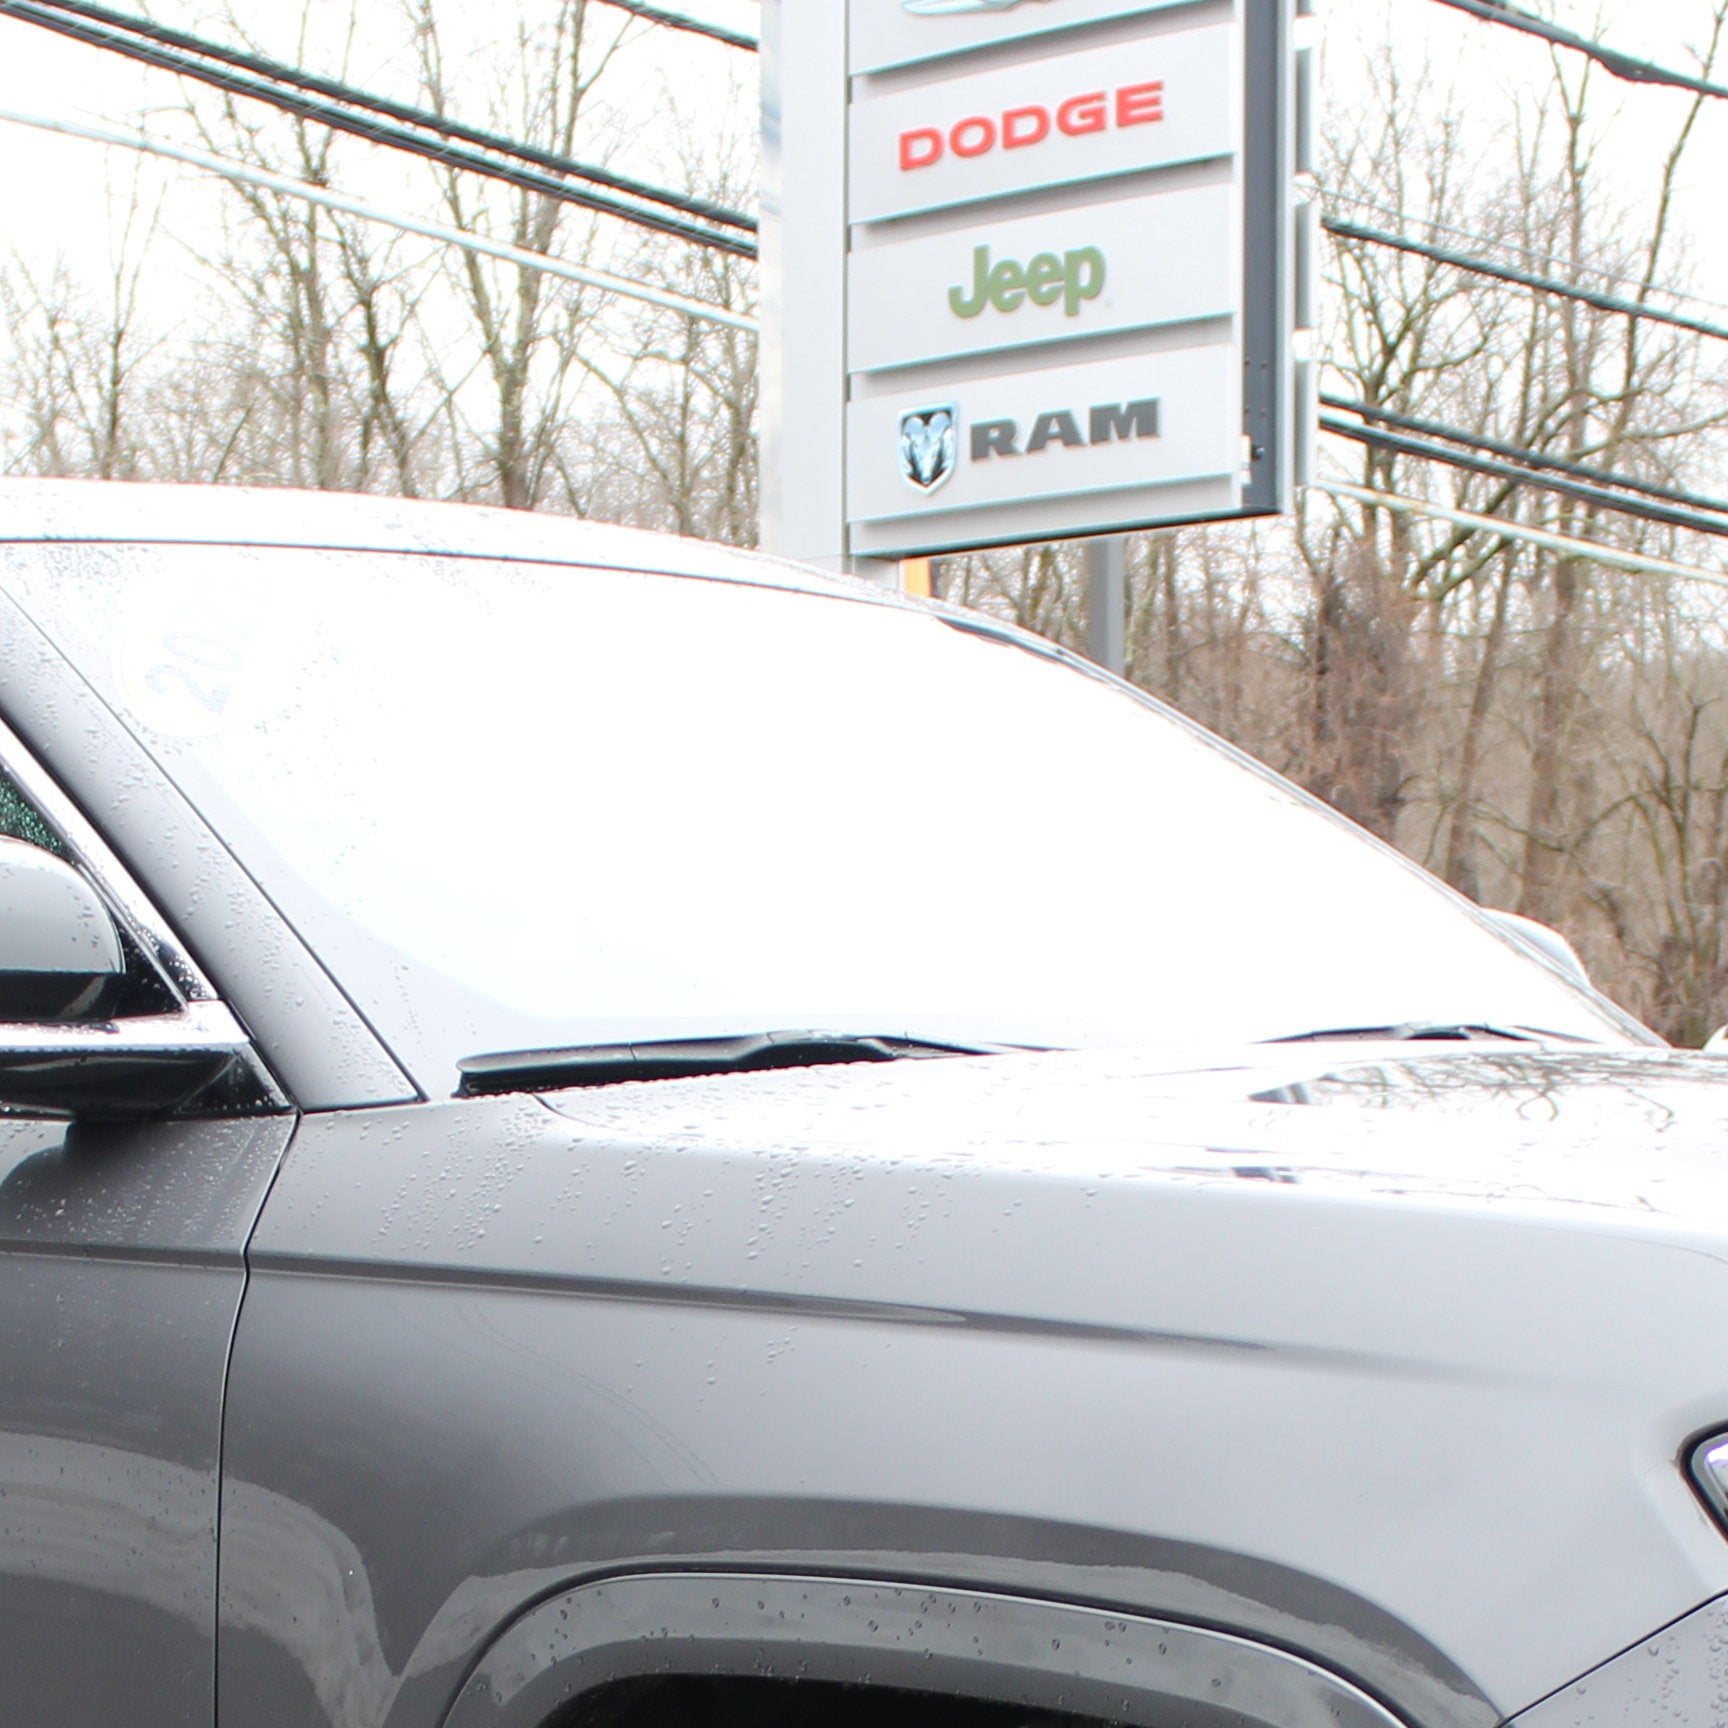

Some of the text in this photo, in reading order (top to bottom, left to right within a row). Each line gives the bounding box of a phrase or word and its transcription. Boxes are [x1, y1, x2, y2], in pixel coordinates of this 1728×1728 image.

[898, 79, 1165, 172] DODGE
[947, 243, 1106, 319] Jeep
[969, 396, 1162, 463] RAM
